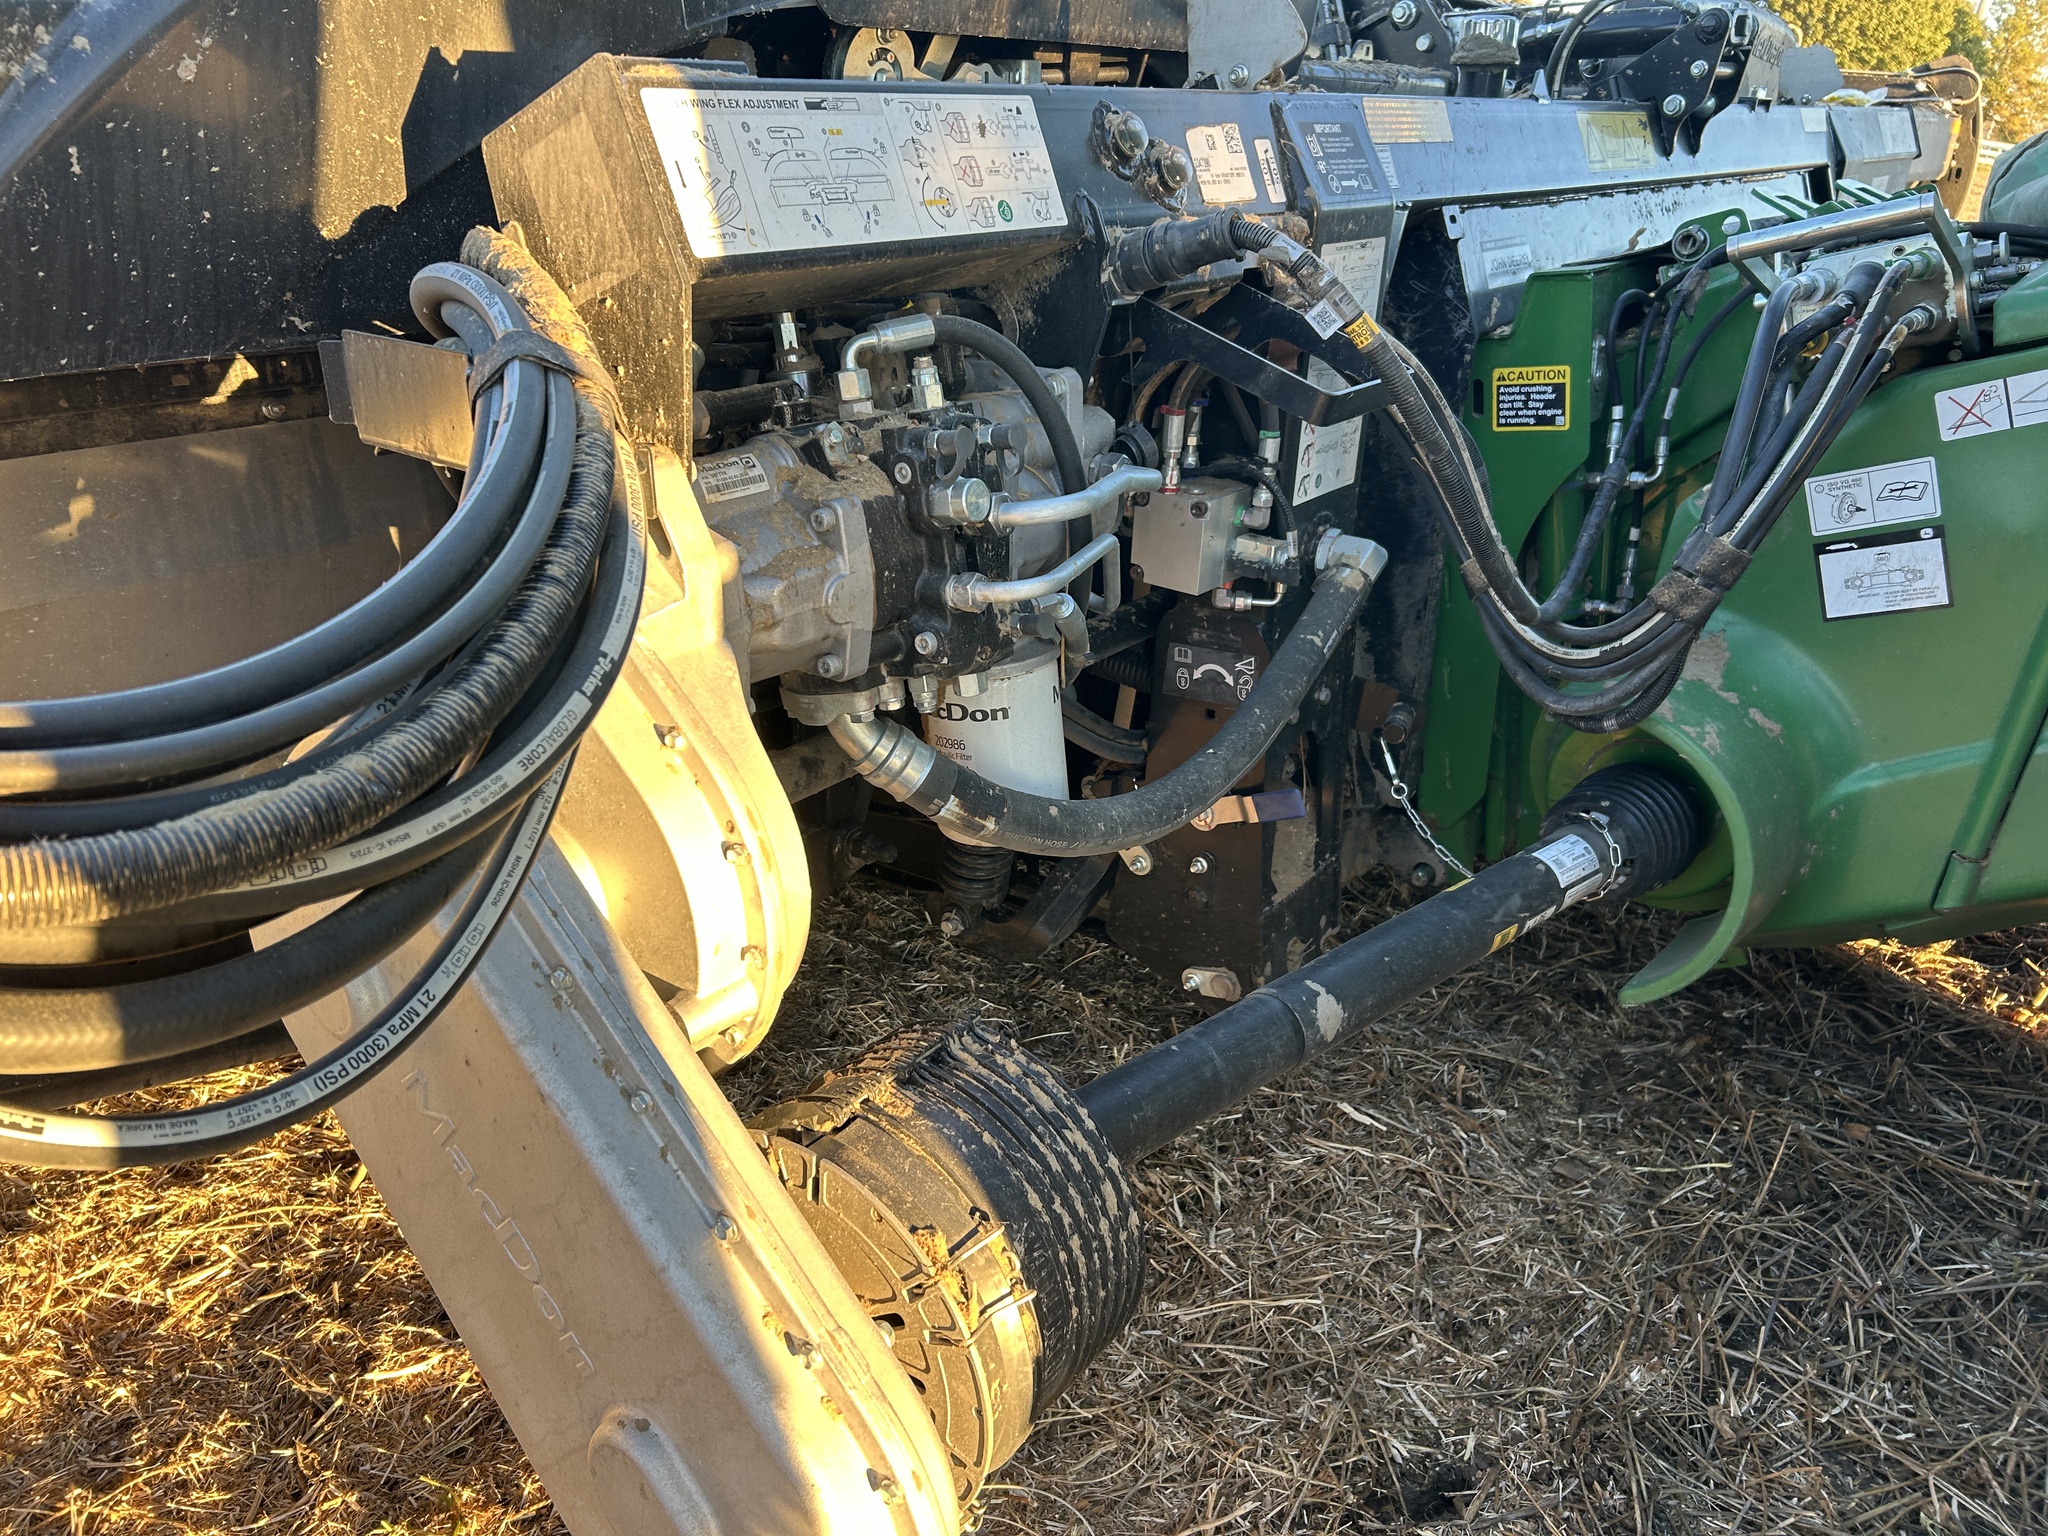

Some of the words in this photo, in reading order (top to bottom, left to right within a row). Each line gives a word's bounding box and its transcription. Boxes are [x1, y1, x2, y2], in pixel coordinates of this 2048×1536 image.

[690, 99, 716, 108] WING
[718, 99, 741, 109] FLEX
[743, 99, 800, 109] ADJUSTMENT
[1313, 124, 1342, 133] IMPORTANT
[1507, 369, 1566, 381] CAUTION
[1521, 385, 1552, 393] crushing
[1528, 401, 1544, 409] Stay
[1538, 408, 1562, 416] engine
[624, 460, 637, 481] MPa
[697, 460, 739, 473] MacDon
[1828, 483, 1862, 492] SYNTHETIC
[629, 481, 643, 512] (3000
[583, 651, 618, 697] Parker
[936, 702, 1011, 723] cDon
[517, 709, 579, 772] GLOBALCORE
[935, 734, 966, 751] 202986
[955, 753, 973, 761] Filter
[543, 795, 554, 812] 12,5
[533, 811, 547, 828] mm
[385, 832, 412, 848] MSHA
[1003, 831, 1044, 845] SUCTION
[1043, 838, 1069, 849] HOSE
[505, 855, 523, 880] MSHA
[416, 988, 437, 1009] 21
[387, 1004, 423, 1037] MPa
[346, 1031, 392, 1072] (3000
[312, 1064, 349, 1094] PSI)
[173, 1117, 198, 1129] MADE
[402, 1068, 597, 1377] MacDon
